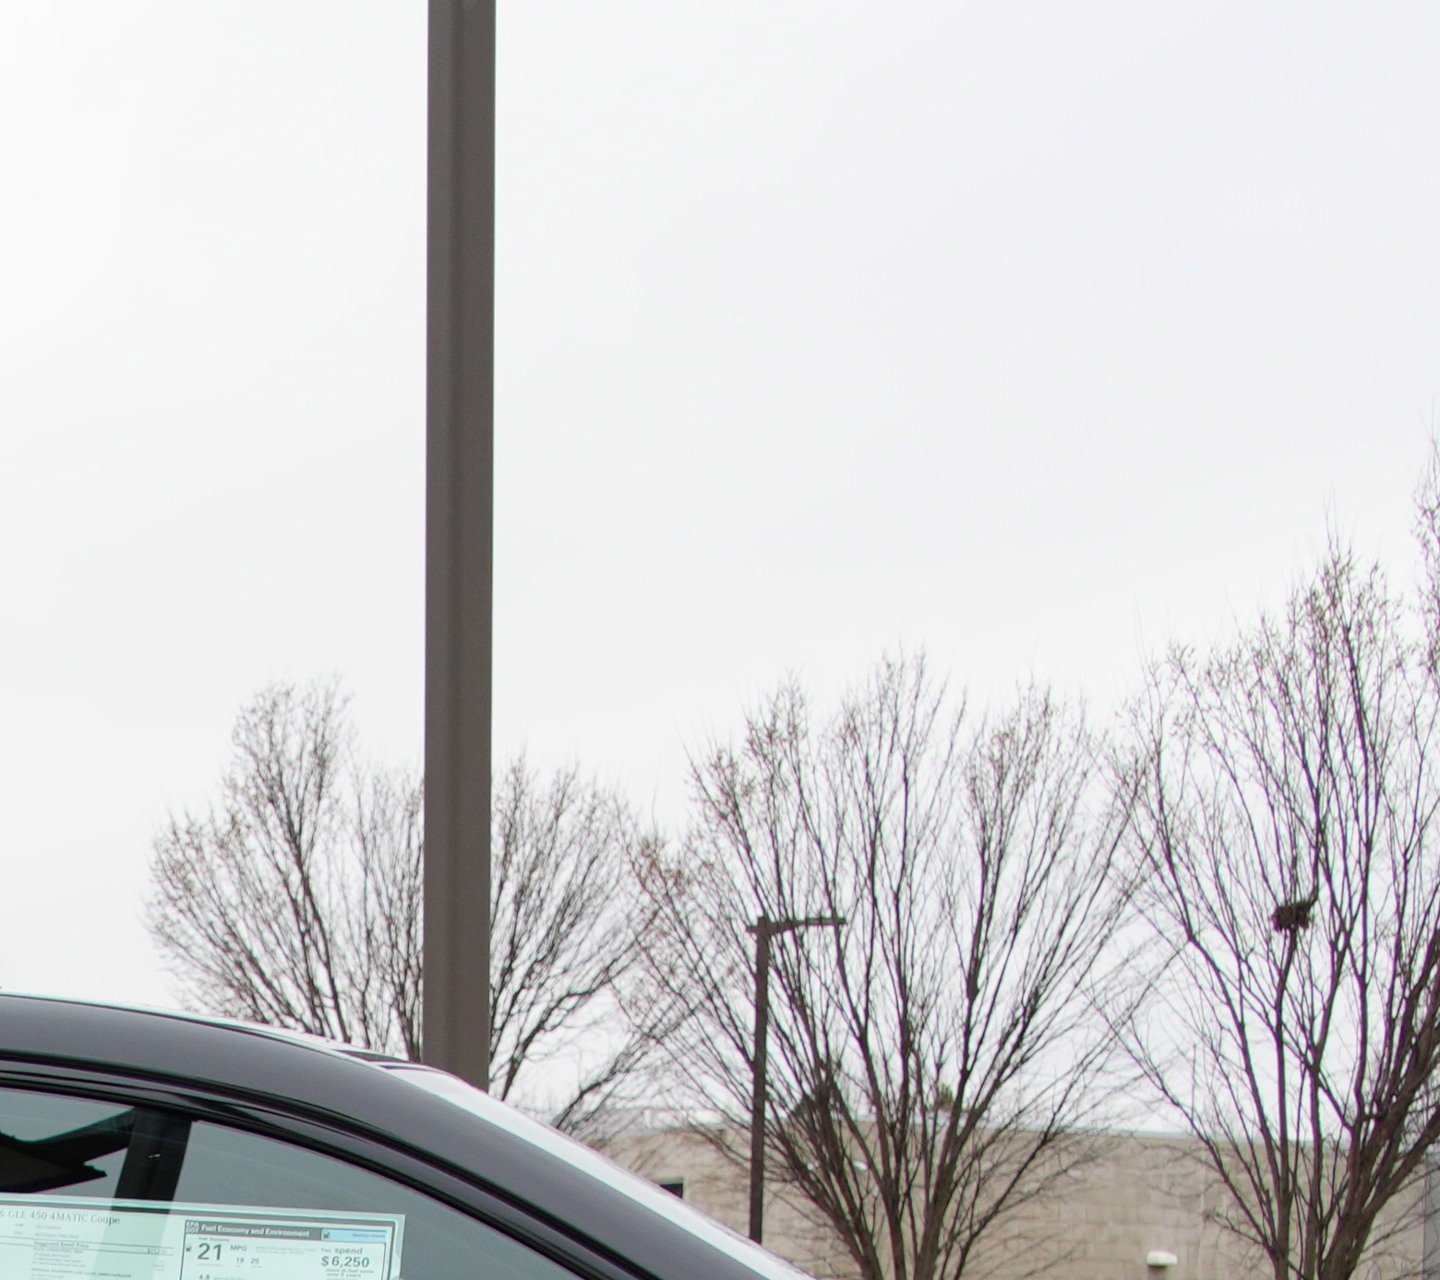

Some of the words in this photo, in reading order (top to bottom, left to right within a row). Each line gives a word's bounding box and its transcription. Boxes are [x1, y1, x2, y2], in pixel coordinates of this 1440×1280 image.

[8, 1209, 26, 1219] GLE
[29, 1210, 47, 1220] 450
[50, 1211, 88, 1223] 4MATIC
[90, 1214, 120, 1226] Coupe
[217, 1225, 250, 1235] Economy
[197, 1243, 222, 1260] 21
[335, 1246, 363, 1255] spend
[321, 1255, 370, 1268] $6,250
